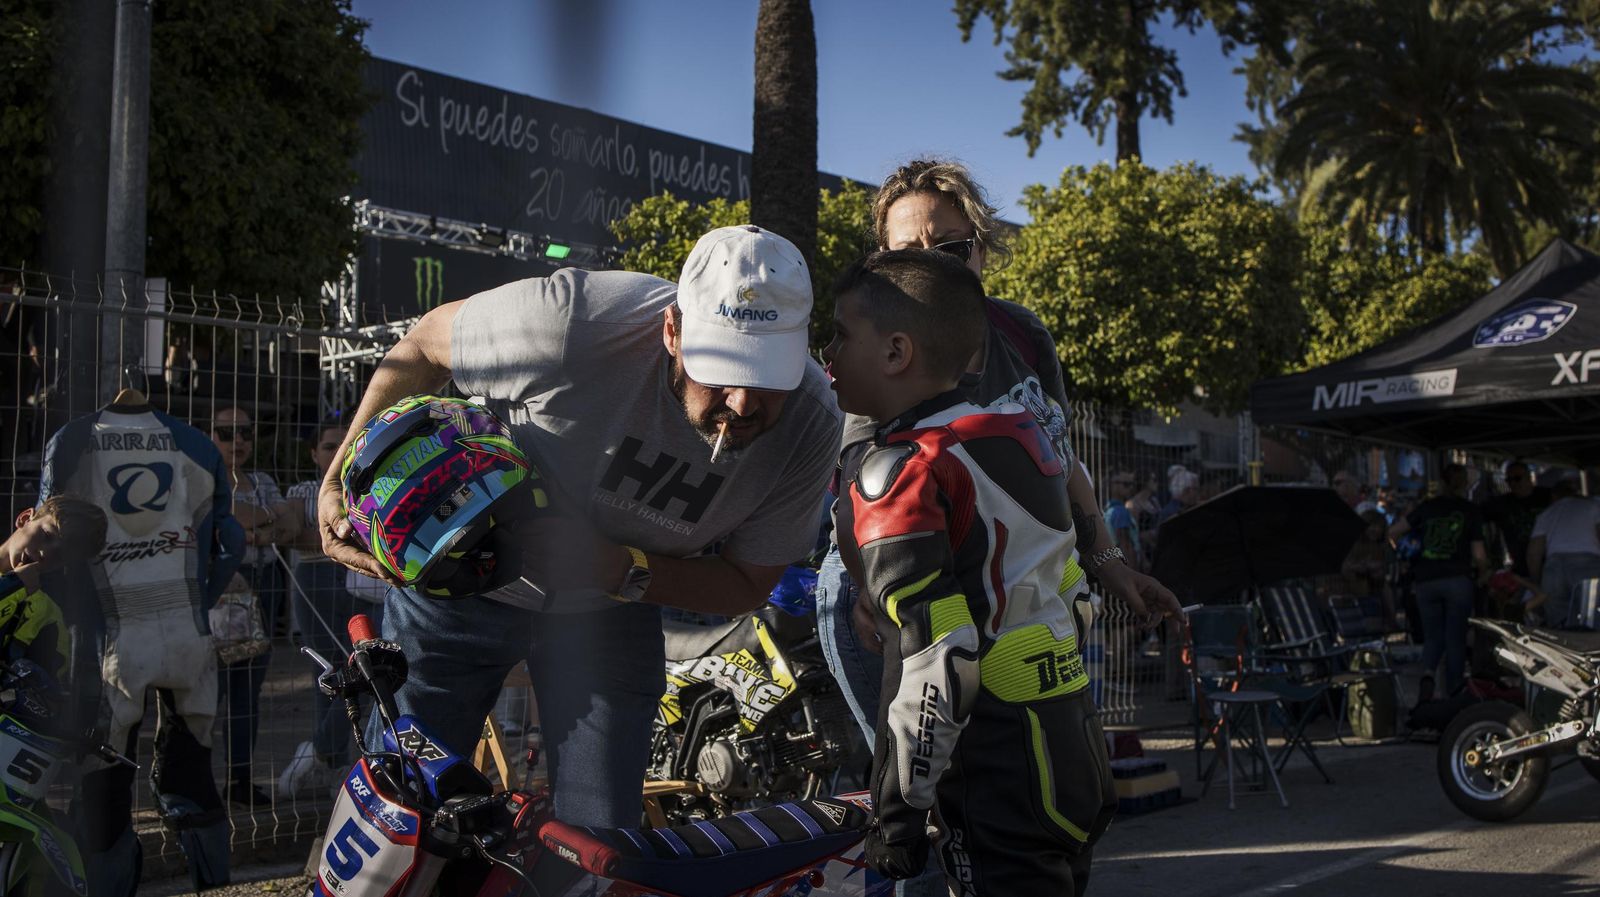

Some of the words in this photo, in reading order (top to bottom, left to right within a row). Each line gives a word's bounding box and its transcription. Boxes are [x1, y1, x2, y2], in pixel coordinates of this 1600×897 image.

[396, 70, 429, 127] Si
[440, 96, 539, 153] puedes
[649, 141, 732, 197] puedes
[526, 168, 565, 221] 20
[714, 303, 778, 321] JIMANG
[1312, 378, 1384, 411] MIR
[1386, 375, 1451, 396] RACING
[370, 431, 446, 507] CRISTIAN
[594, 492, 636, 513] HELLY
[637, 506, 695, 536] HANSEN
[731, 651, 763, 678] TEAM
[399, 724, 448, 761] RXF
[909, 681, 939, 785] DEGEND
[7, 748, 50, 785] 5
[350, 774, 371, 797] RXF
[326, 816, 381, 881] 5
